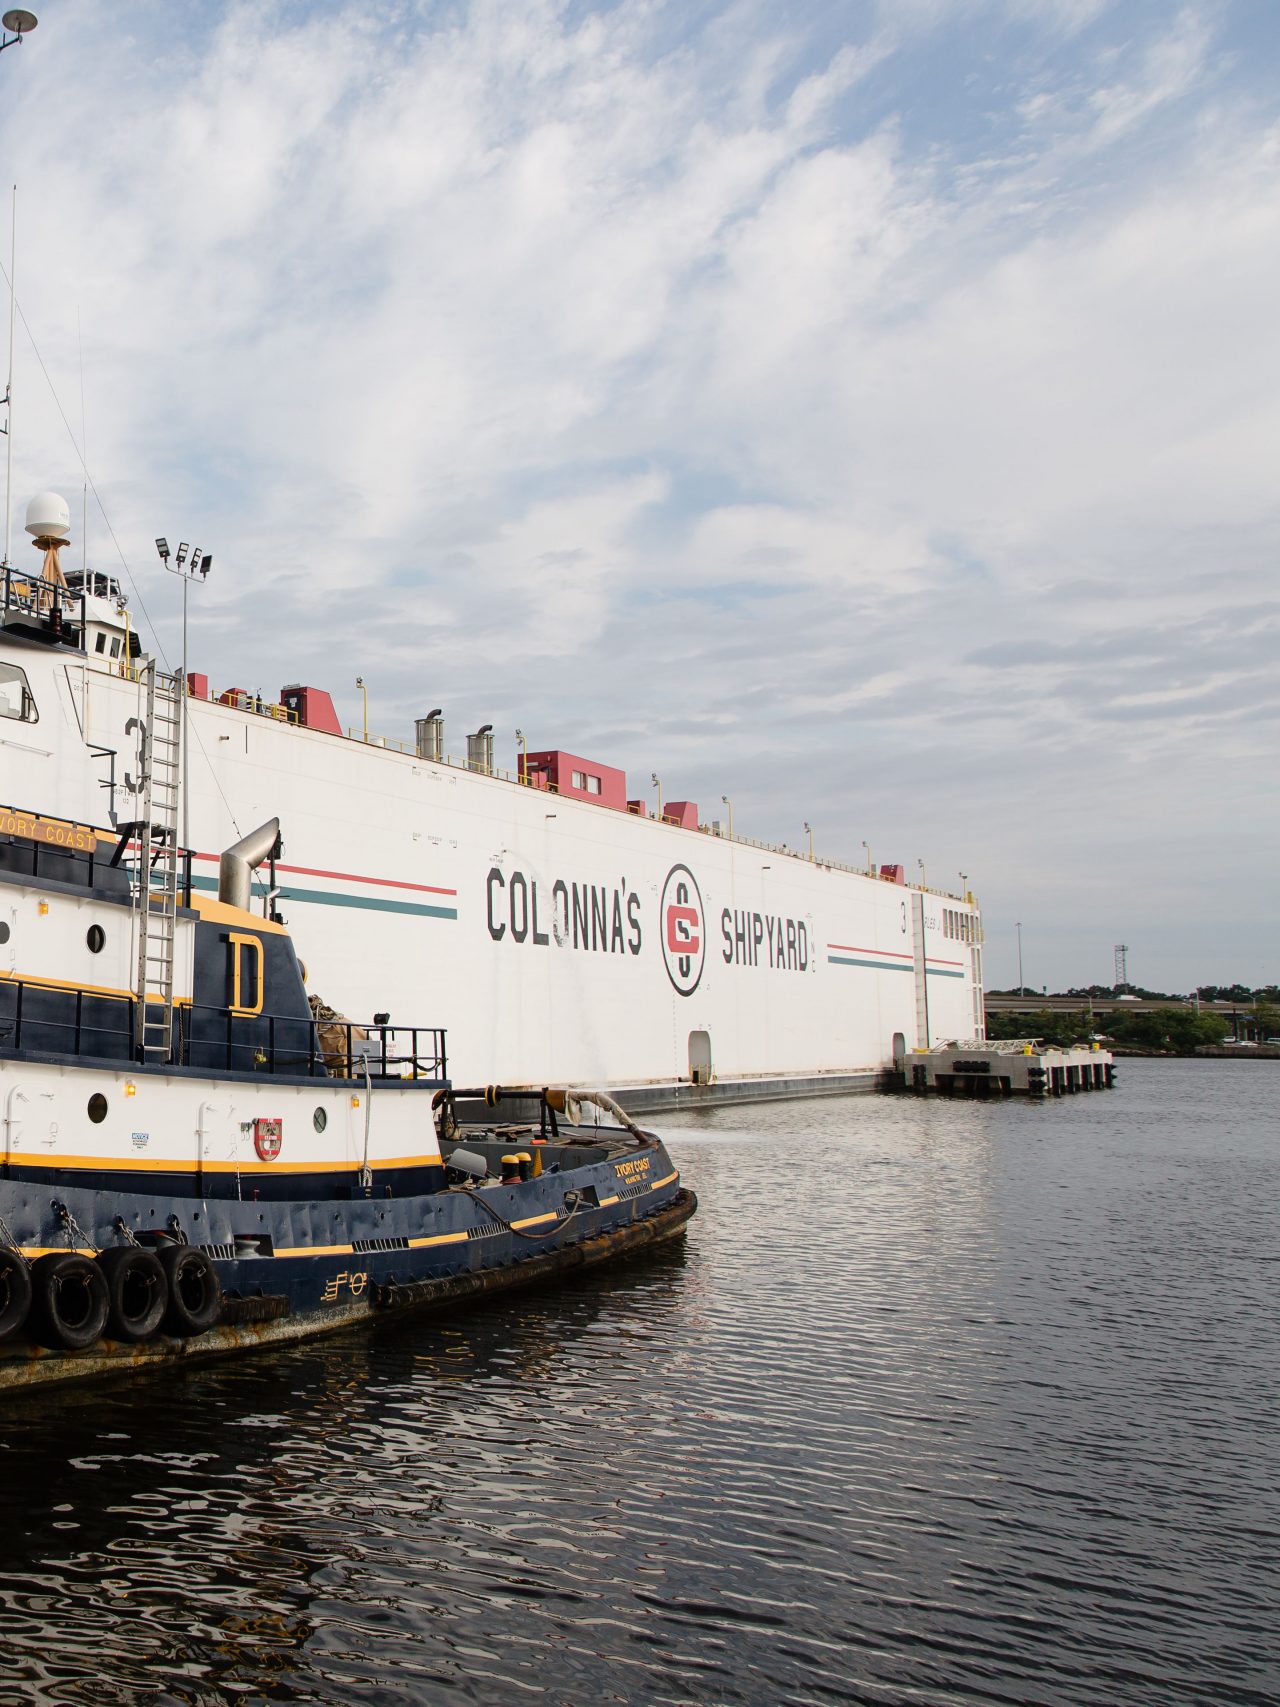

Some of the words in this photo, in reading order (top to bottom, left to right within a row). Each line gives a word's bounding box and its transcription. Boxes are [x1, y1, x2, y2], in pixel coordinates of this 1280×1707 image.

[45, 825, 94, 850] COAST
[486, 867, 642, 956] COLONNA'S
[721, 907, 808, 972] SHIPYARD
[228, 931, 265, 1019] D
[614, 1162, 634, 1177] IVORY
[634, 1157, 650, 1172] COAST
